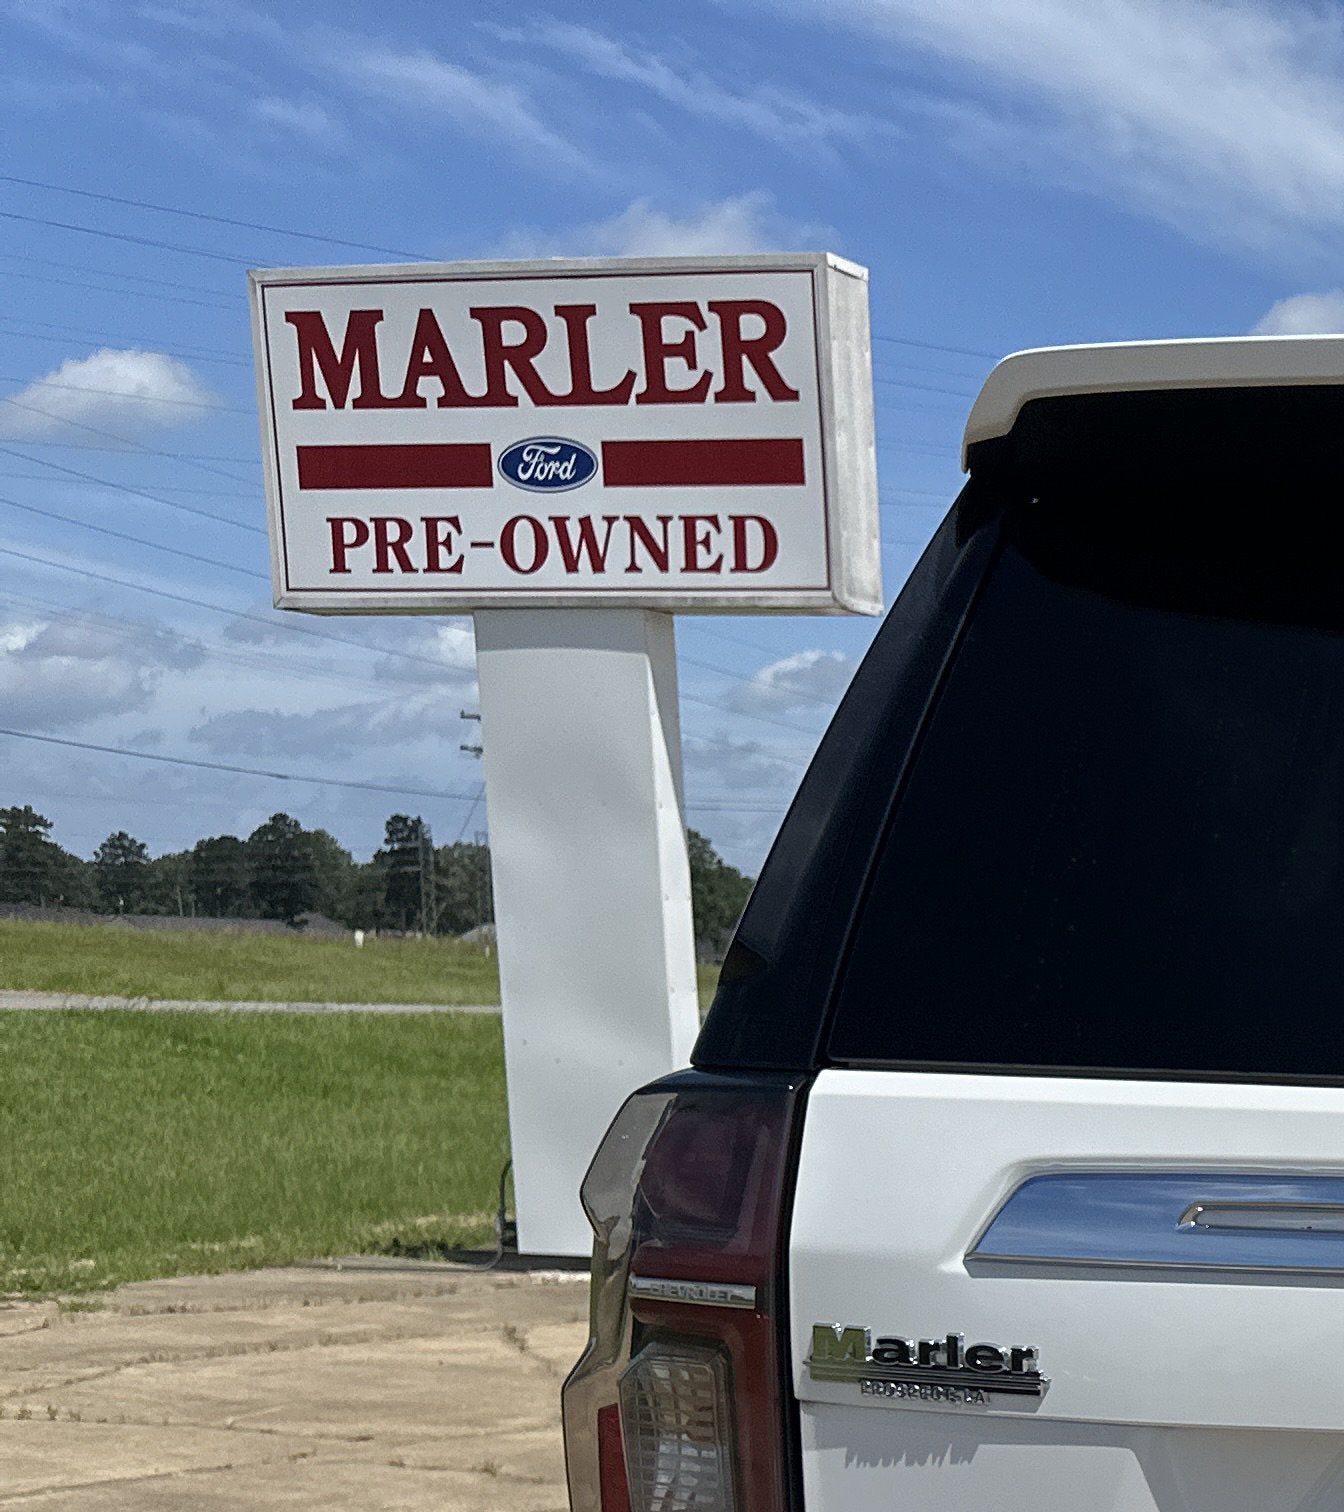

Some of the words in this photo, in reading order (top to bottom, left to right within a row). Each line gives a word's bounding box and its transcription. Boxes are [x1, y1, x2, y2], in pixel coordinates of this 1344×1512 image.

[284, 299, 800, 410] MARLER
[516, 443, 578, 483] Ford
[326, 513, 779, 576] PRE-OWNED
[811, 1321, 1040, 1374] Marler
